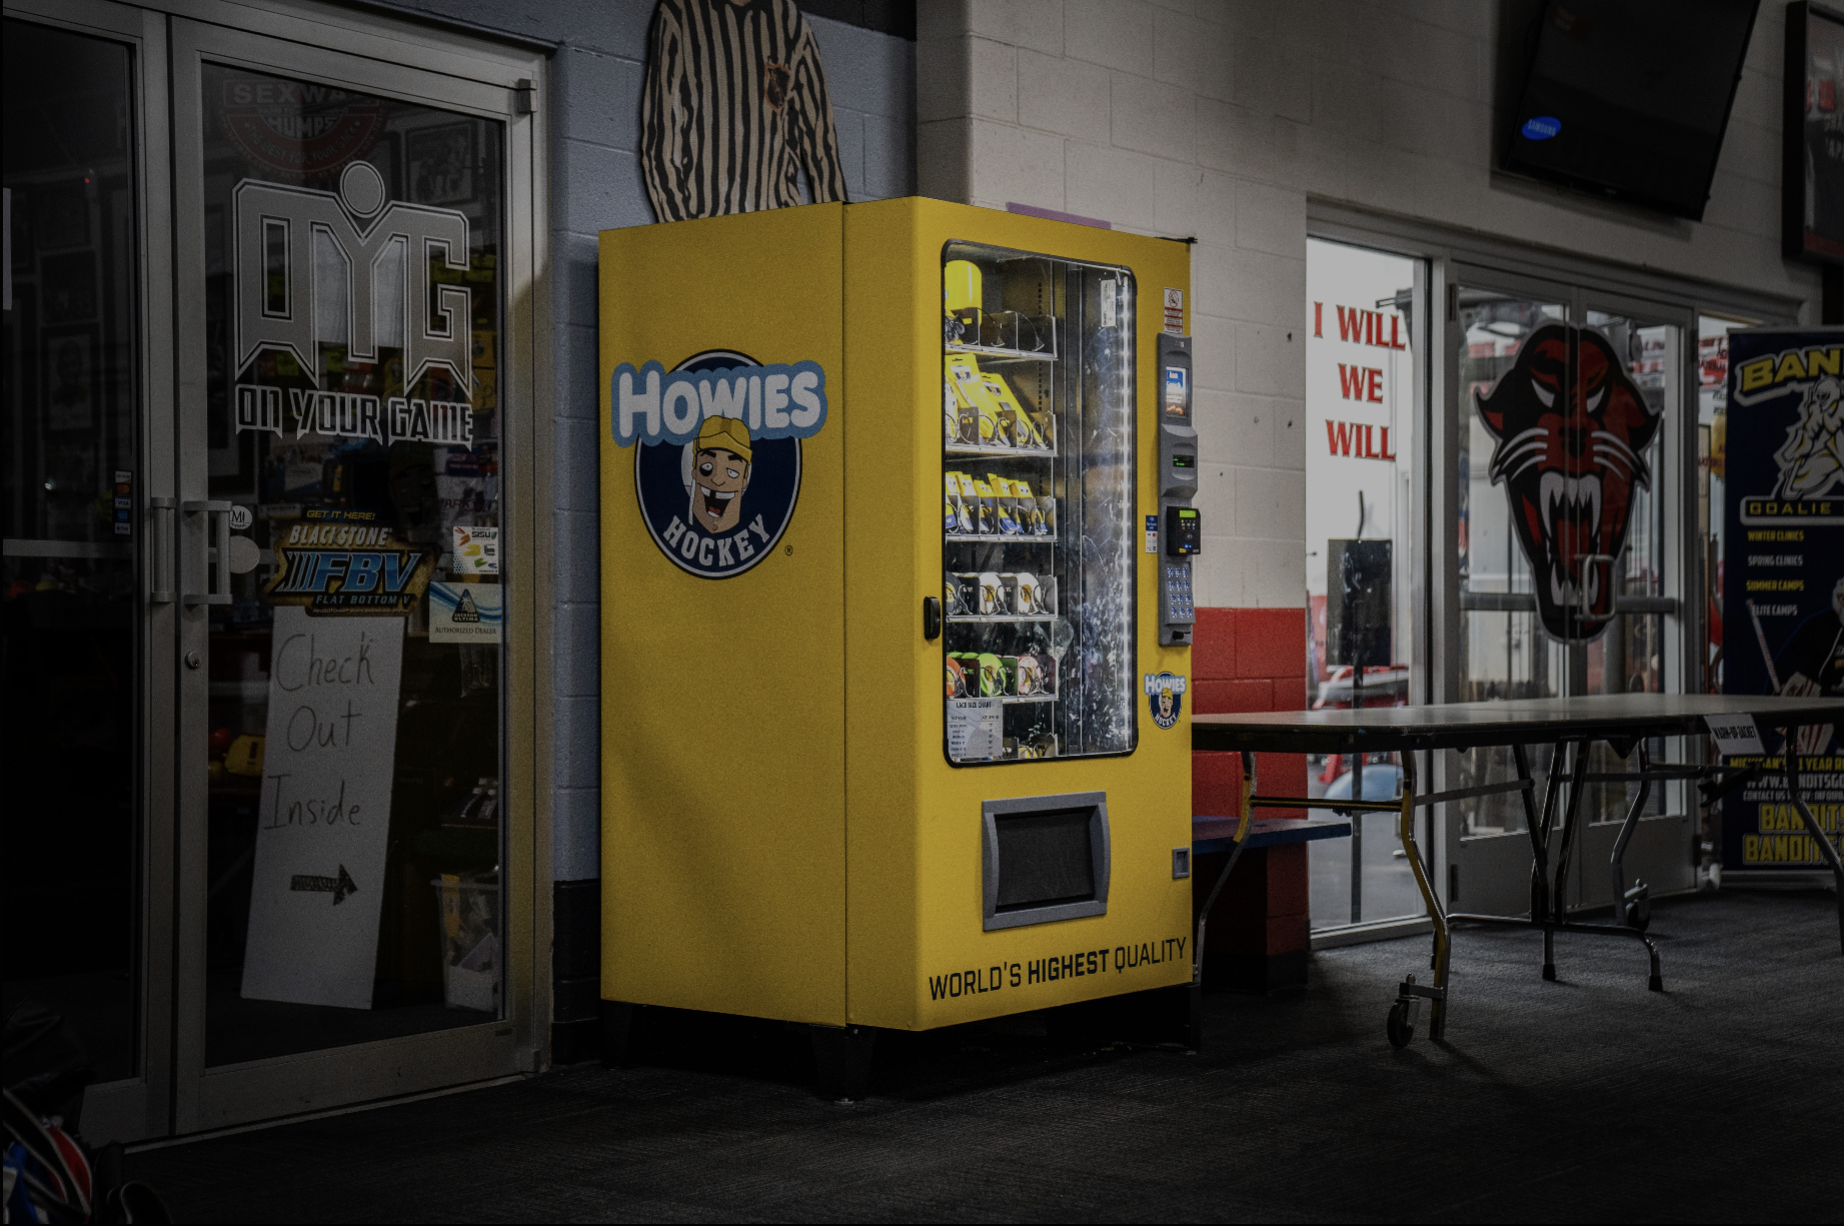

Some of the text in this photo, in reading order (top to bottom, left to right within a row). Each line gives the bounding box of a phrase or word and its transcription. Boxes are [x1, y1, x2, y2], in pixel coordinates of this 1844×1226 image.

[232, 83, 346, 104] SEXWA
[1527, 118, 1555, 137] SAMSUNG
[1313, 301, 1406, 351] I WILL
[1742, 348, 1844, 392] BAN
[1338, 362, 1383, 404] WE
[618, 369, 822, 439] HOWIES
[235, 384, 473, 453] ON YOUR GAME
[1325, 419, 1396, 462] WILL
[306, 509, 329, 519] GET
[331, 511, 342, 519] IT
[343, 511, 376, 521] HERE!
[1749, 502, 1831, 515] GOALIE
[289, 525, 389, 546] BLACKSTONE
[472, 530, 491, 538] SISU
[662, 513, 771, 567] HOCKEY
[1747, 530, 1804, 542] WINTER CLINICS
[1747, 555, 1803, 567] SPRING CLINICS
[310, 551, 423, 593] FBV
[1746, 580, 1804, 591] SUMMER CAMPS
[315, 595, 411, 605] FLAT BOTTOM V
[1752, 604, 1797, 616] ELITE CAMPS
[474, 626, 497, 634] DEALER
[276, 631, 375, 691] Check
[1145, 675, 1185, 693] HOWIES
[286, 699, 362, 751] Out
[1154, 712, 1177, 726] HOCKEY
[1711, 726, 1756, 740] WARM-UP JACKET
[1805, 757, 1833, 771] YEAR
[1834, 757, 1844, 771] R
[1746, 774, 1844, 789] WWW.BNDITSGO
[263, 773, 361, 829] Inside
[1743, 790, 1775, 801] CONTACT
[1775, 790, 1786, 801] US
[929, 936, 1187, 1001] WORLD'S HIGHEST QUALITY
